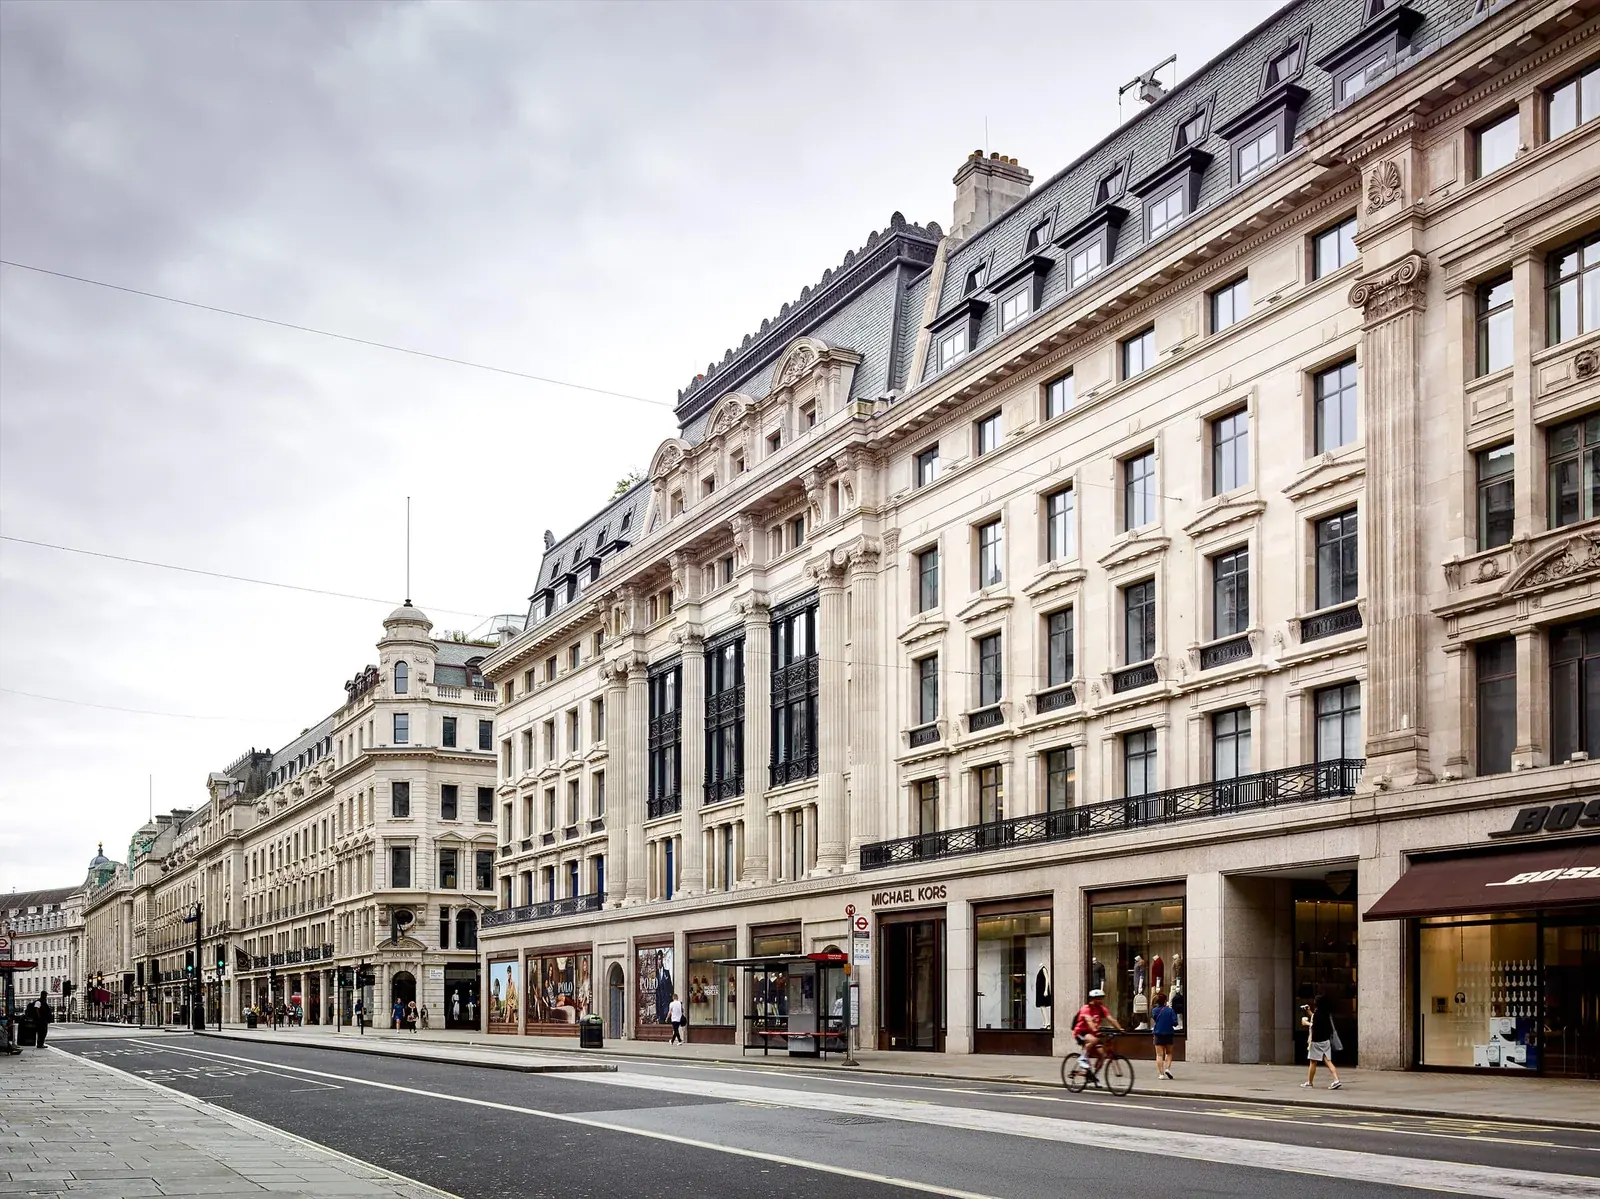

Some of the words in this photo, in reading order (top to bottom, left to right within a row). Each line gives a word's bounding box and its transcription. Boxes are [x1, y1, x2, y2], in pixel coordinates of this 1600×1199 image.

[871, 889, 914, 906] MICHAEL
[918, 885, 947, 901] KORS
[557, 981, 573, 993] POLO
[639, 977, 659, 990] POLO
